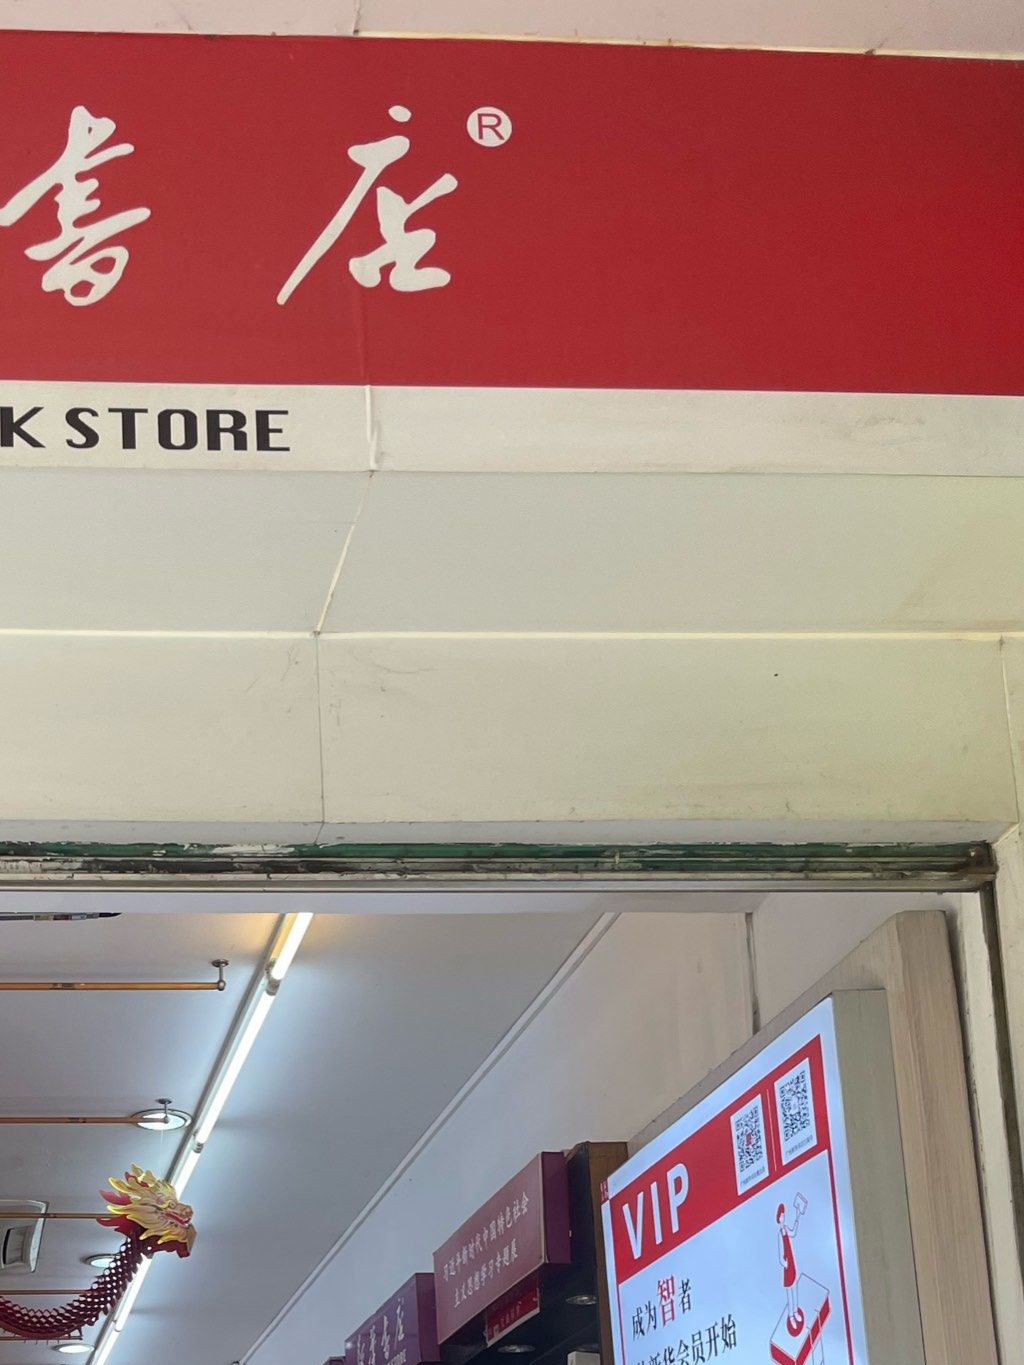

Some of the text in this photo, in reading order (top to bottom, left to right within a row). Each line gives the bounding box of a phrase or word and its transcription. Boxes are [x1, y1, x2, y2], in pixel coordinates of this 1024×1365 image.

[66, 404, 291, 451] STORE
[622, 1163, 690, 1261] VIP
[632, 1275, 693, 1342] 成为智者
